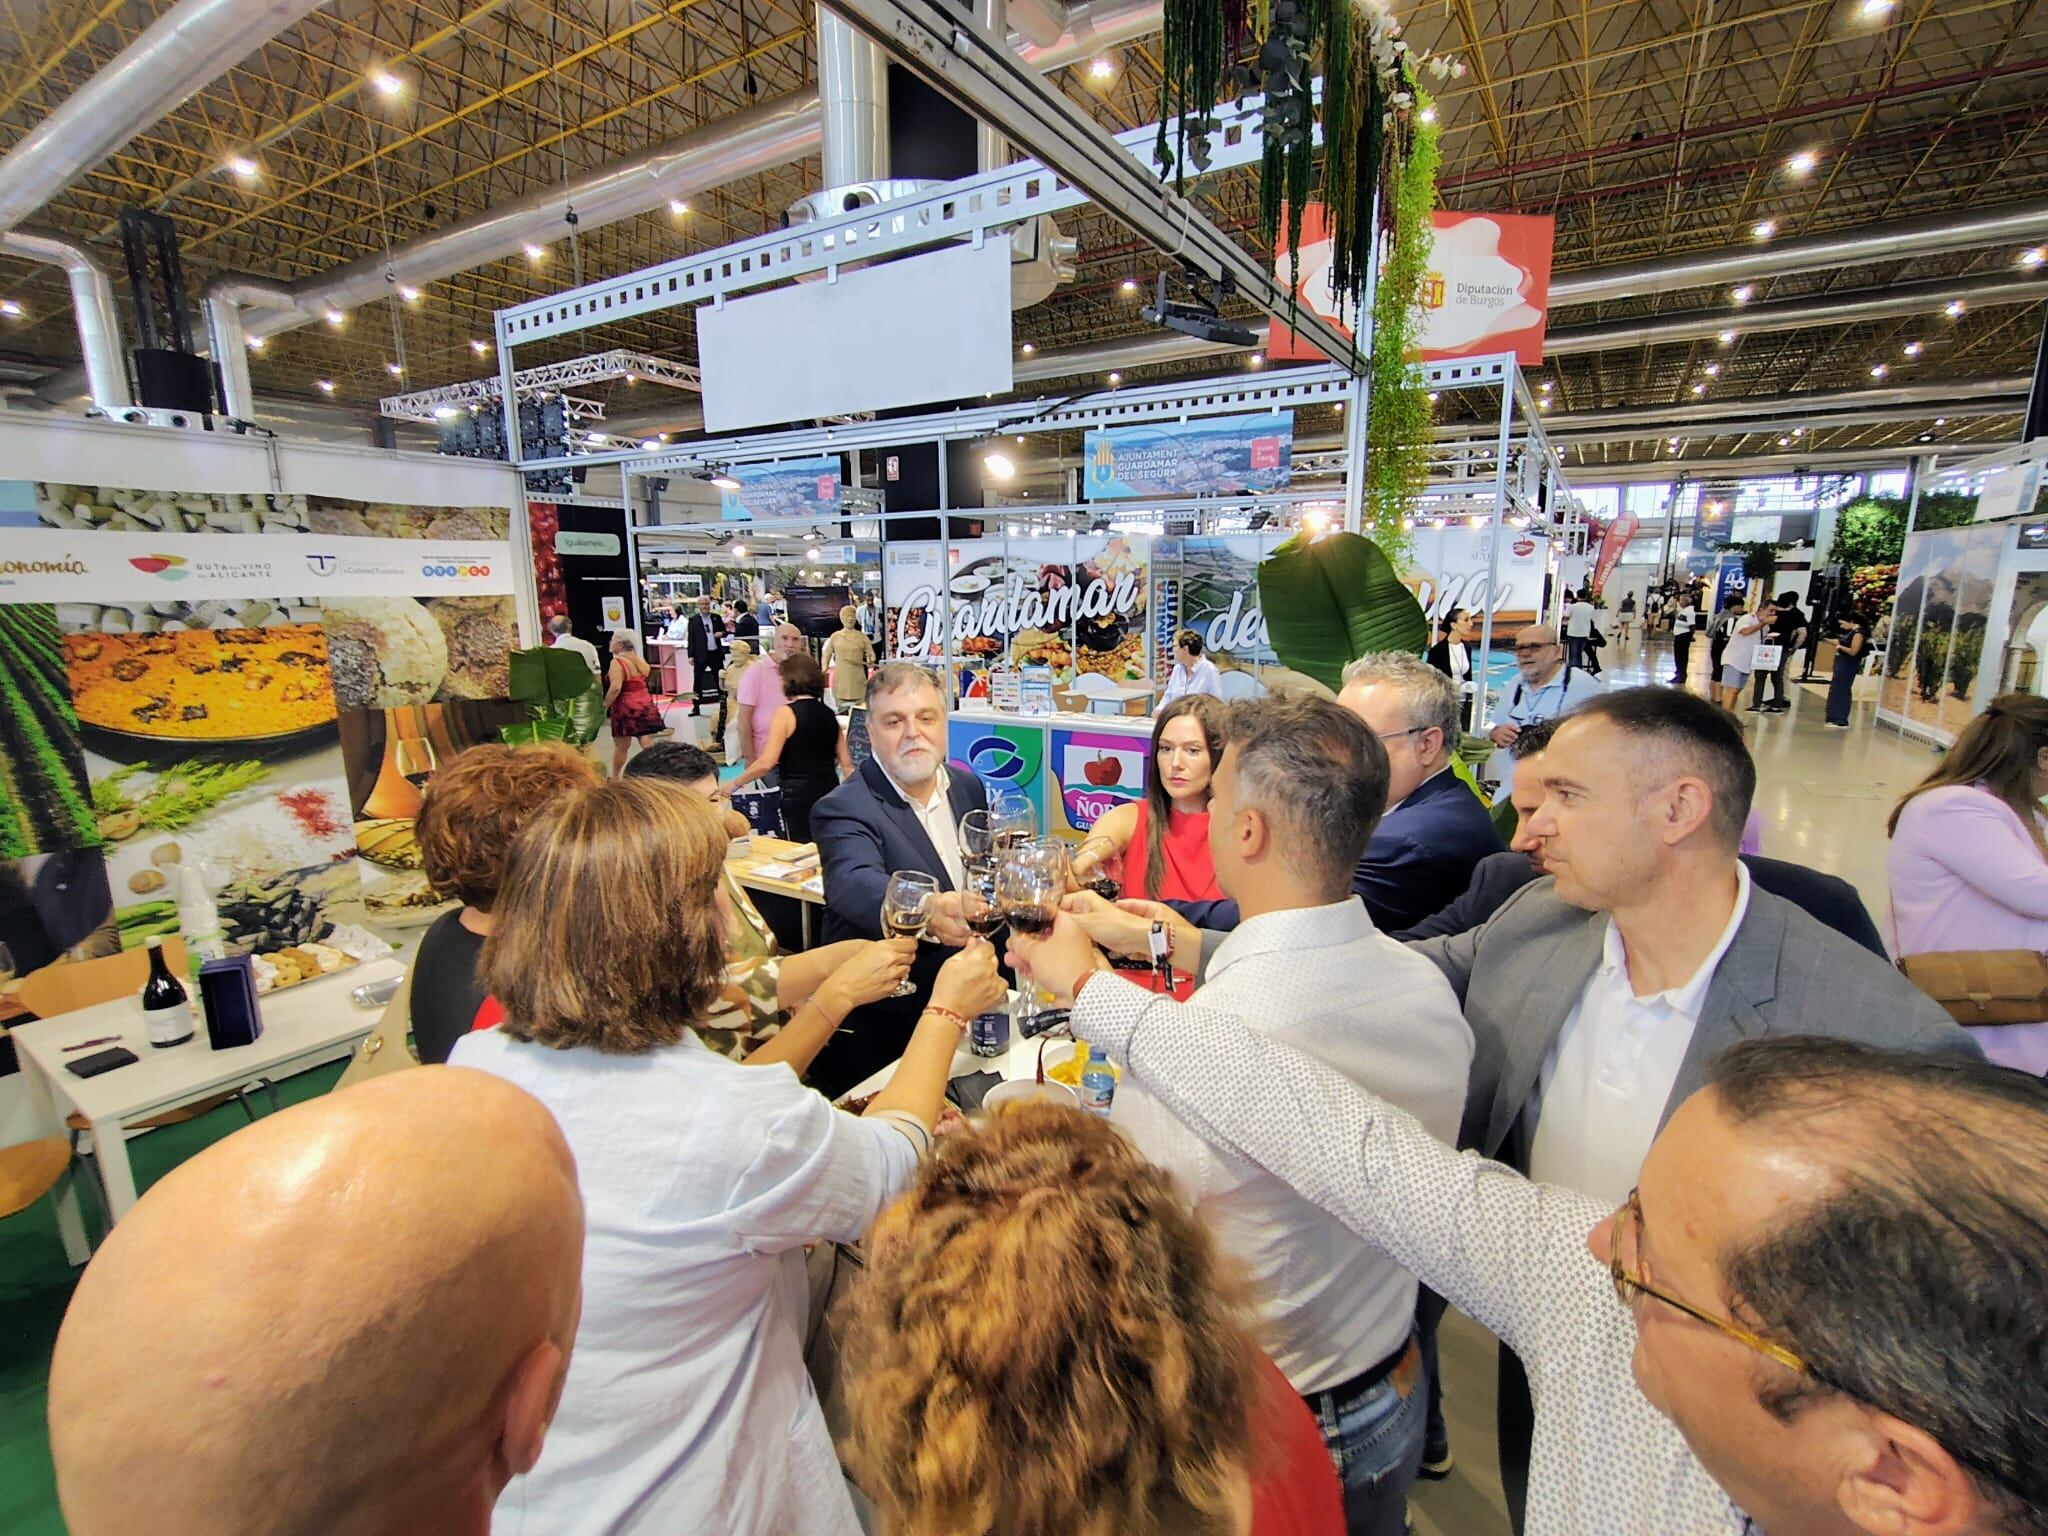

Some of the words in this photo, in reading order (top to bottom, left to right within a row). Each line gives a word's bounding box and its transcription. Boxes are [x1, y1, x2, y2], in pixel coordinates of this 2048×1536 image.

[1457, 282, 1513, 296] Diputación
[1456, 296, 1469, 304] de
[1470, 295, 1504, 308] Burgos
[1117, 450, 1178, 462] AJUNTAMENT
[1117, 459, 1178, 470] GUARDAMAR
[1117, 472, 1136, 481] DEL
[1138, 470, 1177, 479] SEGURA
[241, 562, 272, 570] VINO
[896, 570, 1139, 661] Guardamar
